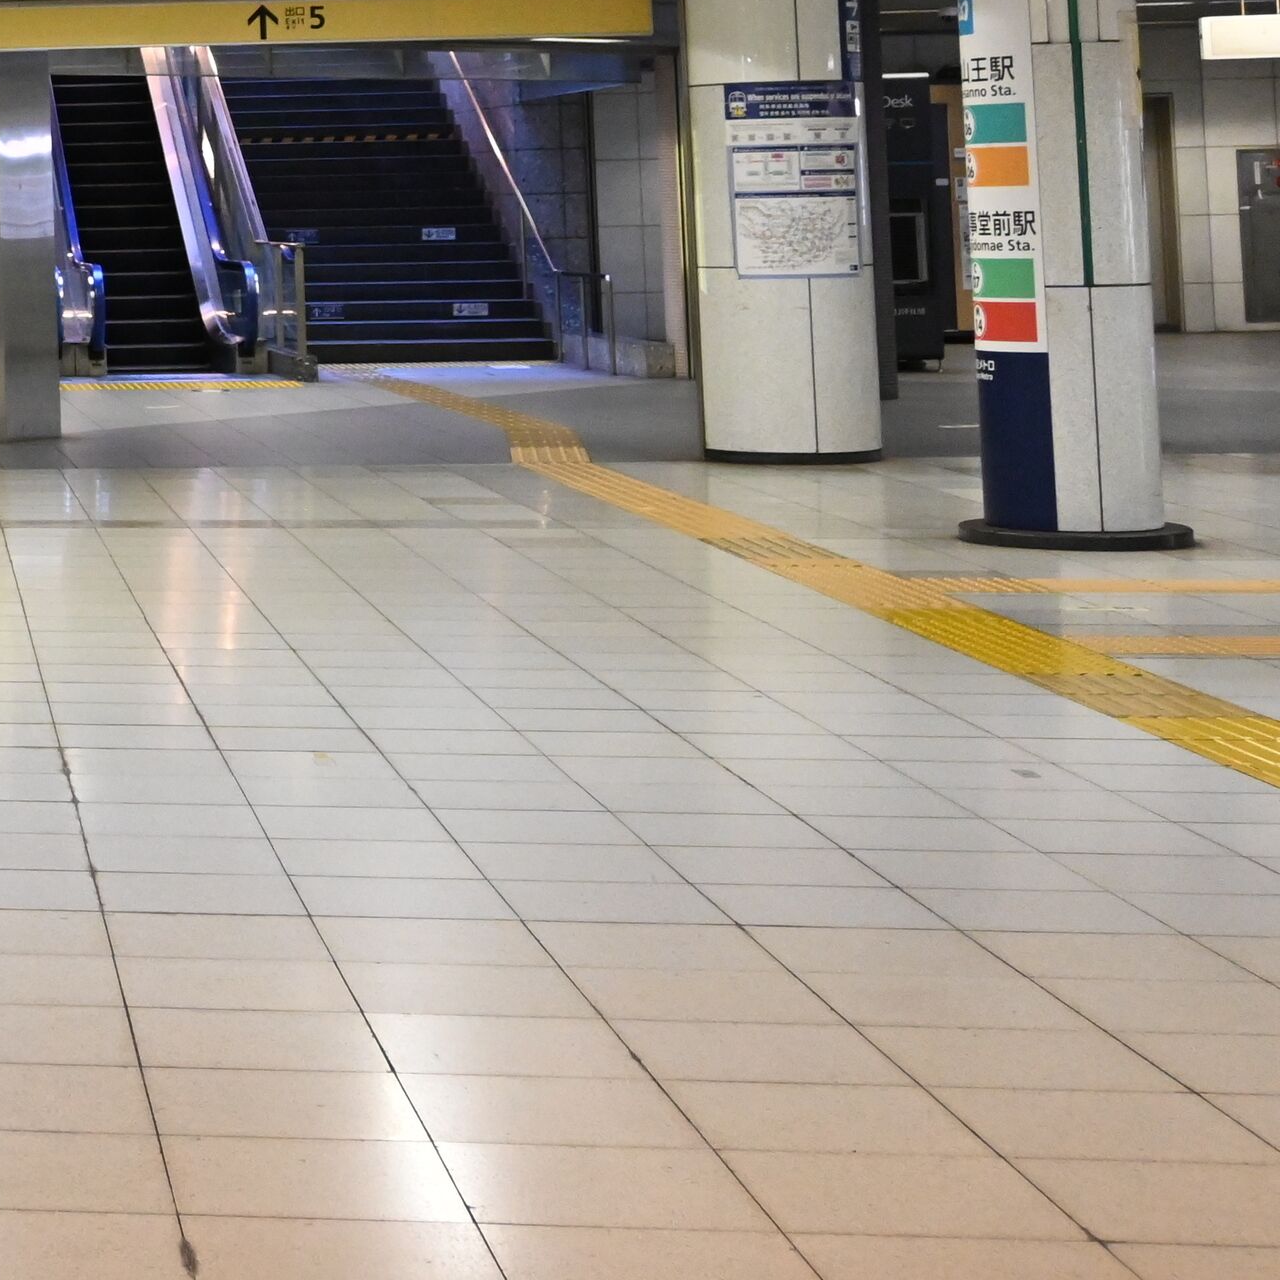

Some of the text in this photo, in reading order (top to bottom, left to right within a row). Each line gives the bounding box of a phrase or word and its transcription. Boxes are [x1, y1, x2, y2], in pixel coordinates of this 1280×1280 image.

[285, 6, 305, 17] 出口
[309, 5, 326, 30] 5
[285, 17, 305, 26] Exit
[990, 84, 1017, 97] Sta.
[1007, 238, 1036, 252] Sta.
